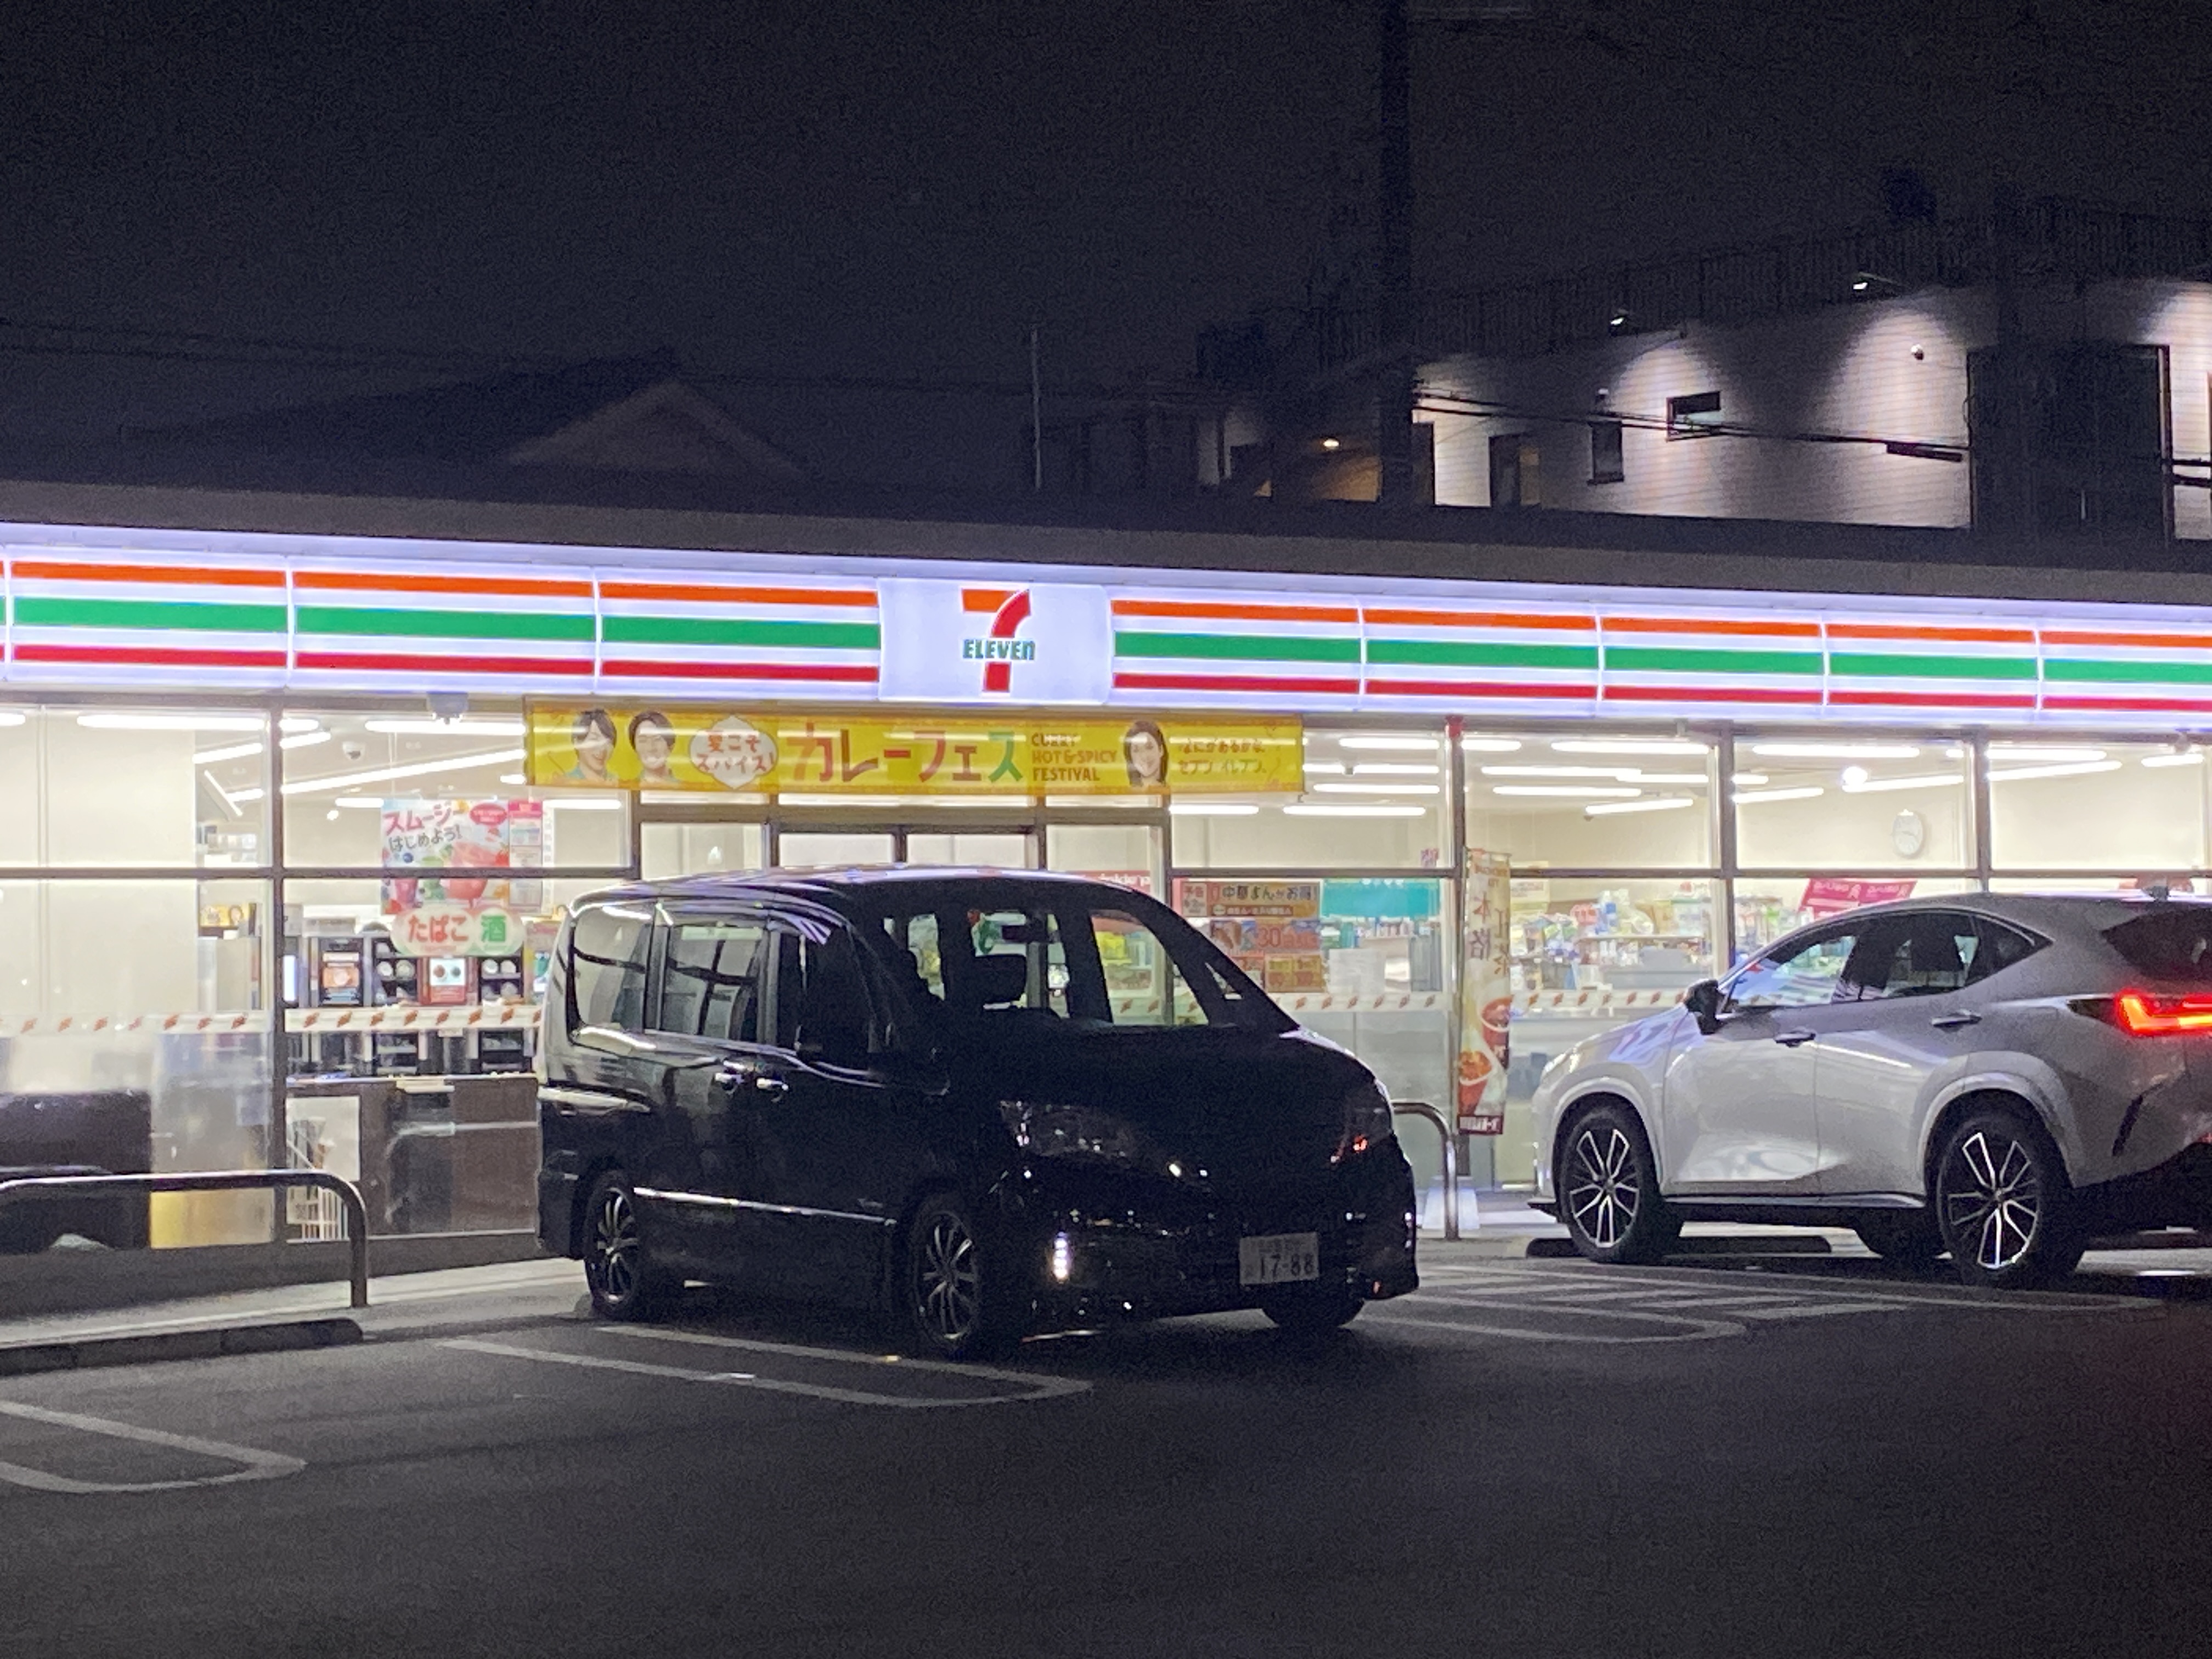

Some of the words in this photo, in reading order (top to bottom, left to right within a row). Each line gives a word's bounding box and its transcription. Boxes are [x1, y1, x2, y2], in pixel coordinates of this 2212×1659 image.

[961, 588, 1031, 692] 7
[786, 722, 1023, 783] カレーフェス
[1032, 767, 1101, 781] FESTIVAL
[383, 800, 463, 836] スムージー
[389, 823, 462, 852] はじめよう!
[408, 915, 469, 943] たばこ
[481, 915, 506, 942] 酒
